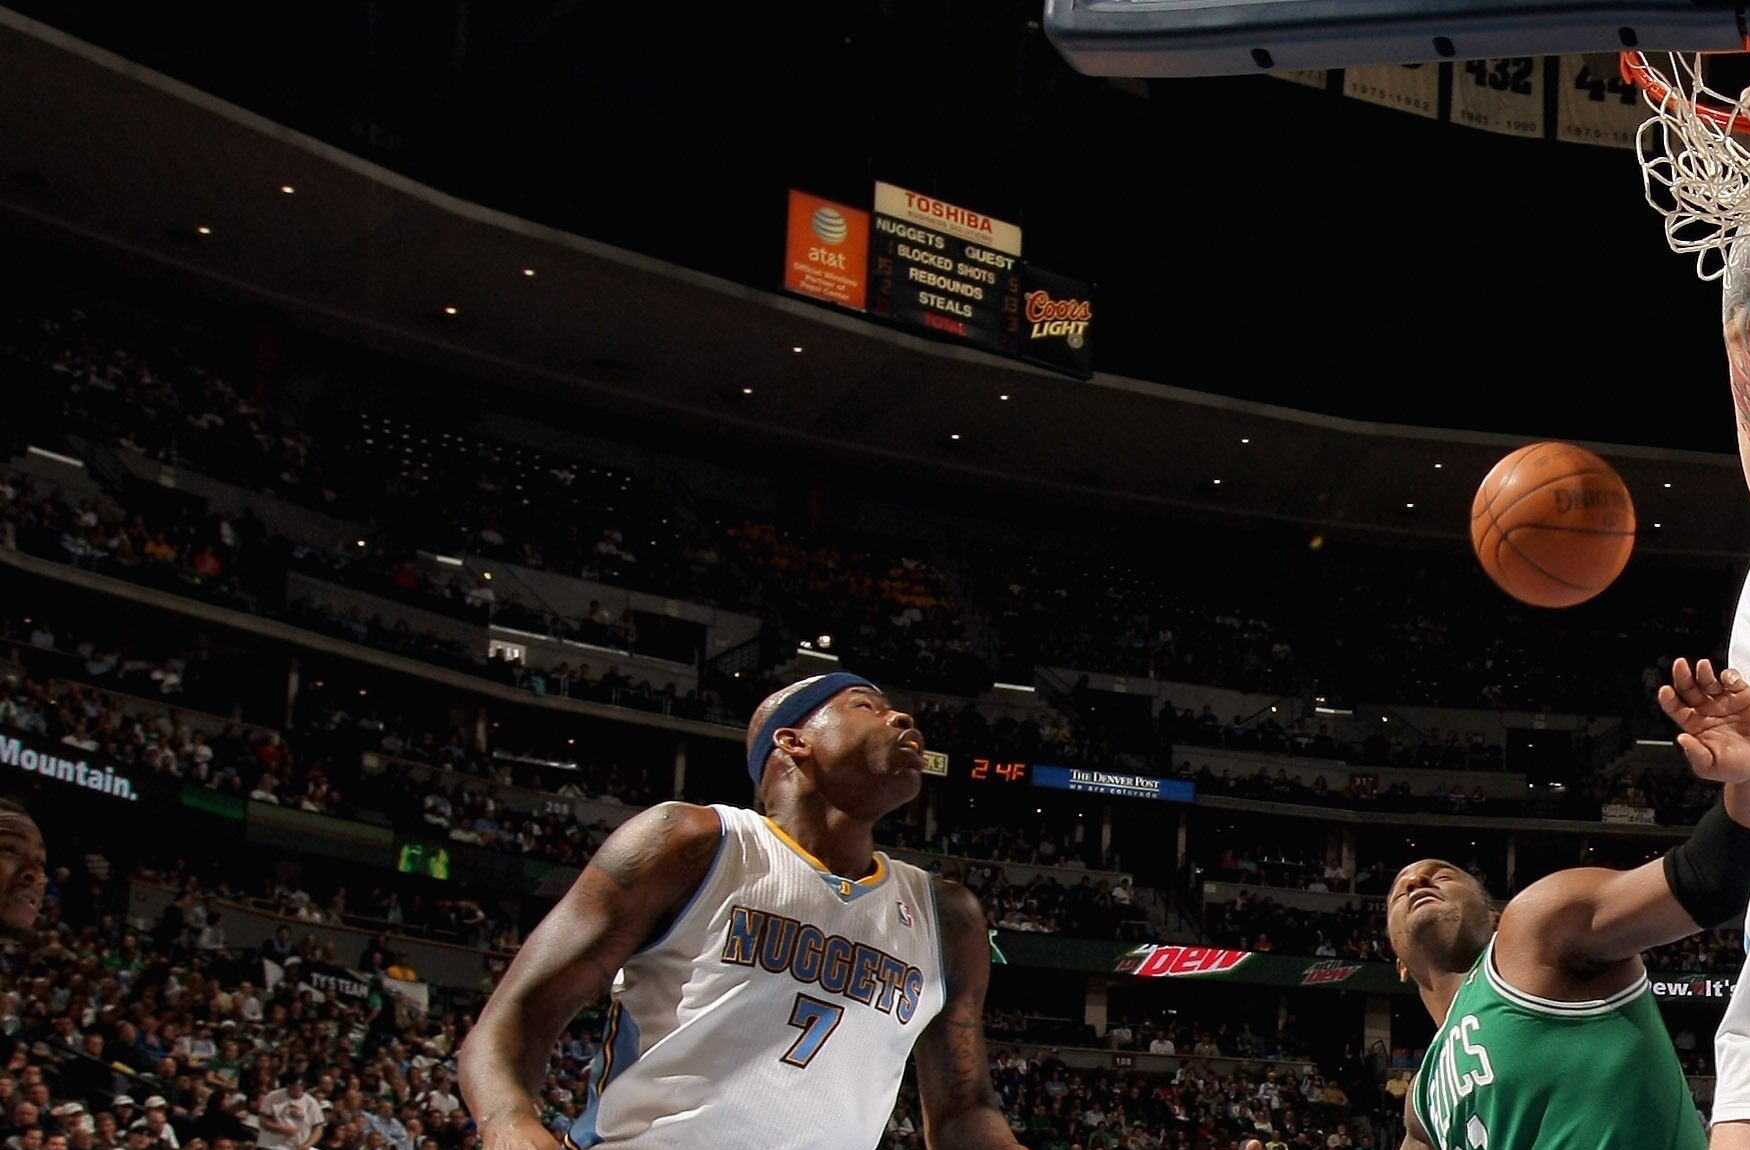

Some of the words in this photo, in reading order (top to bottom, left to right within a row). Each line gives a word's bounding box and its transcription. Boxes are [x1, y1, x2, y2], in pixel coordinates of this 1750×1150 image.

[1464, 57, 1535, 95] 432
[904, 191, 993, 234] TOSHIBA
[808, 246, 847, 271] at&t
[875, 218, 945, 249] NUGGETS
[964, 244, 1016, 271] GUEST
[896, 242, 954, 272] BLOCKED
[956, 261, 996, 285] SHOTS
[908, 265, 984, 301] REBOUNDS
[918, 289, 973, 319] STEALS
[1024, 289, 1093, 323] Coors
[1029, 320, 1090, 340] LIGHT
[0, 734, 139, 801] Mountain.
[1069, 768, 1091, 781] THE
[1092, 771, 1134, 787] DENVER
[1134, 776, 1160, 790] POST
[720, 904, 925, 1026] NUGGETS
[1648, 980, 1693, 996] ew.
[778, 991, 847, 1070] 7
